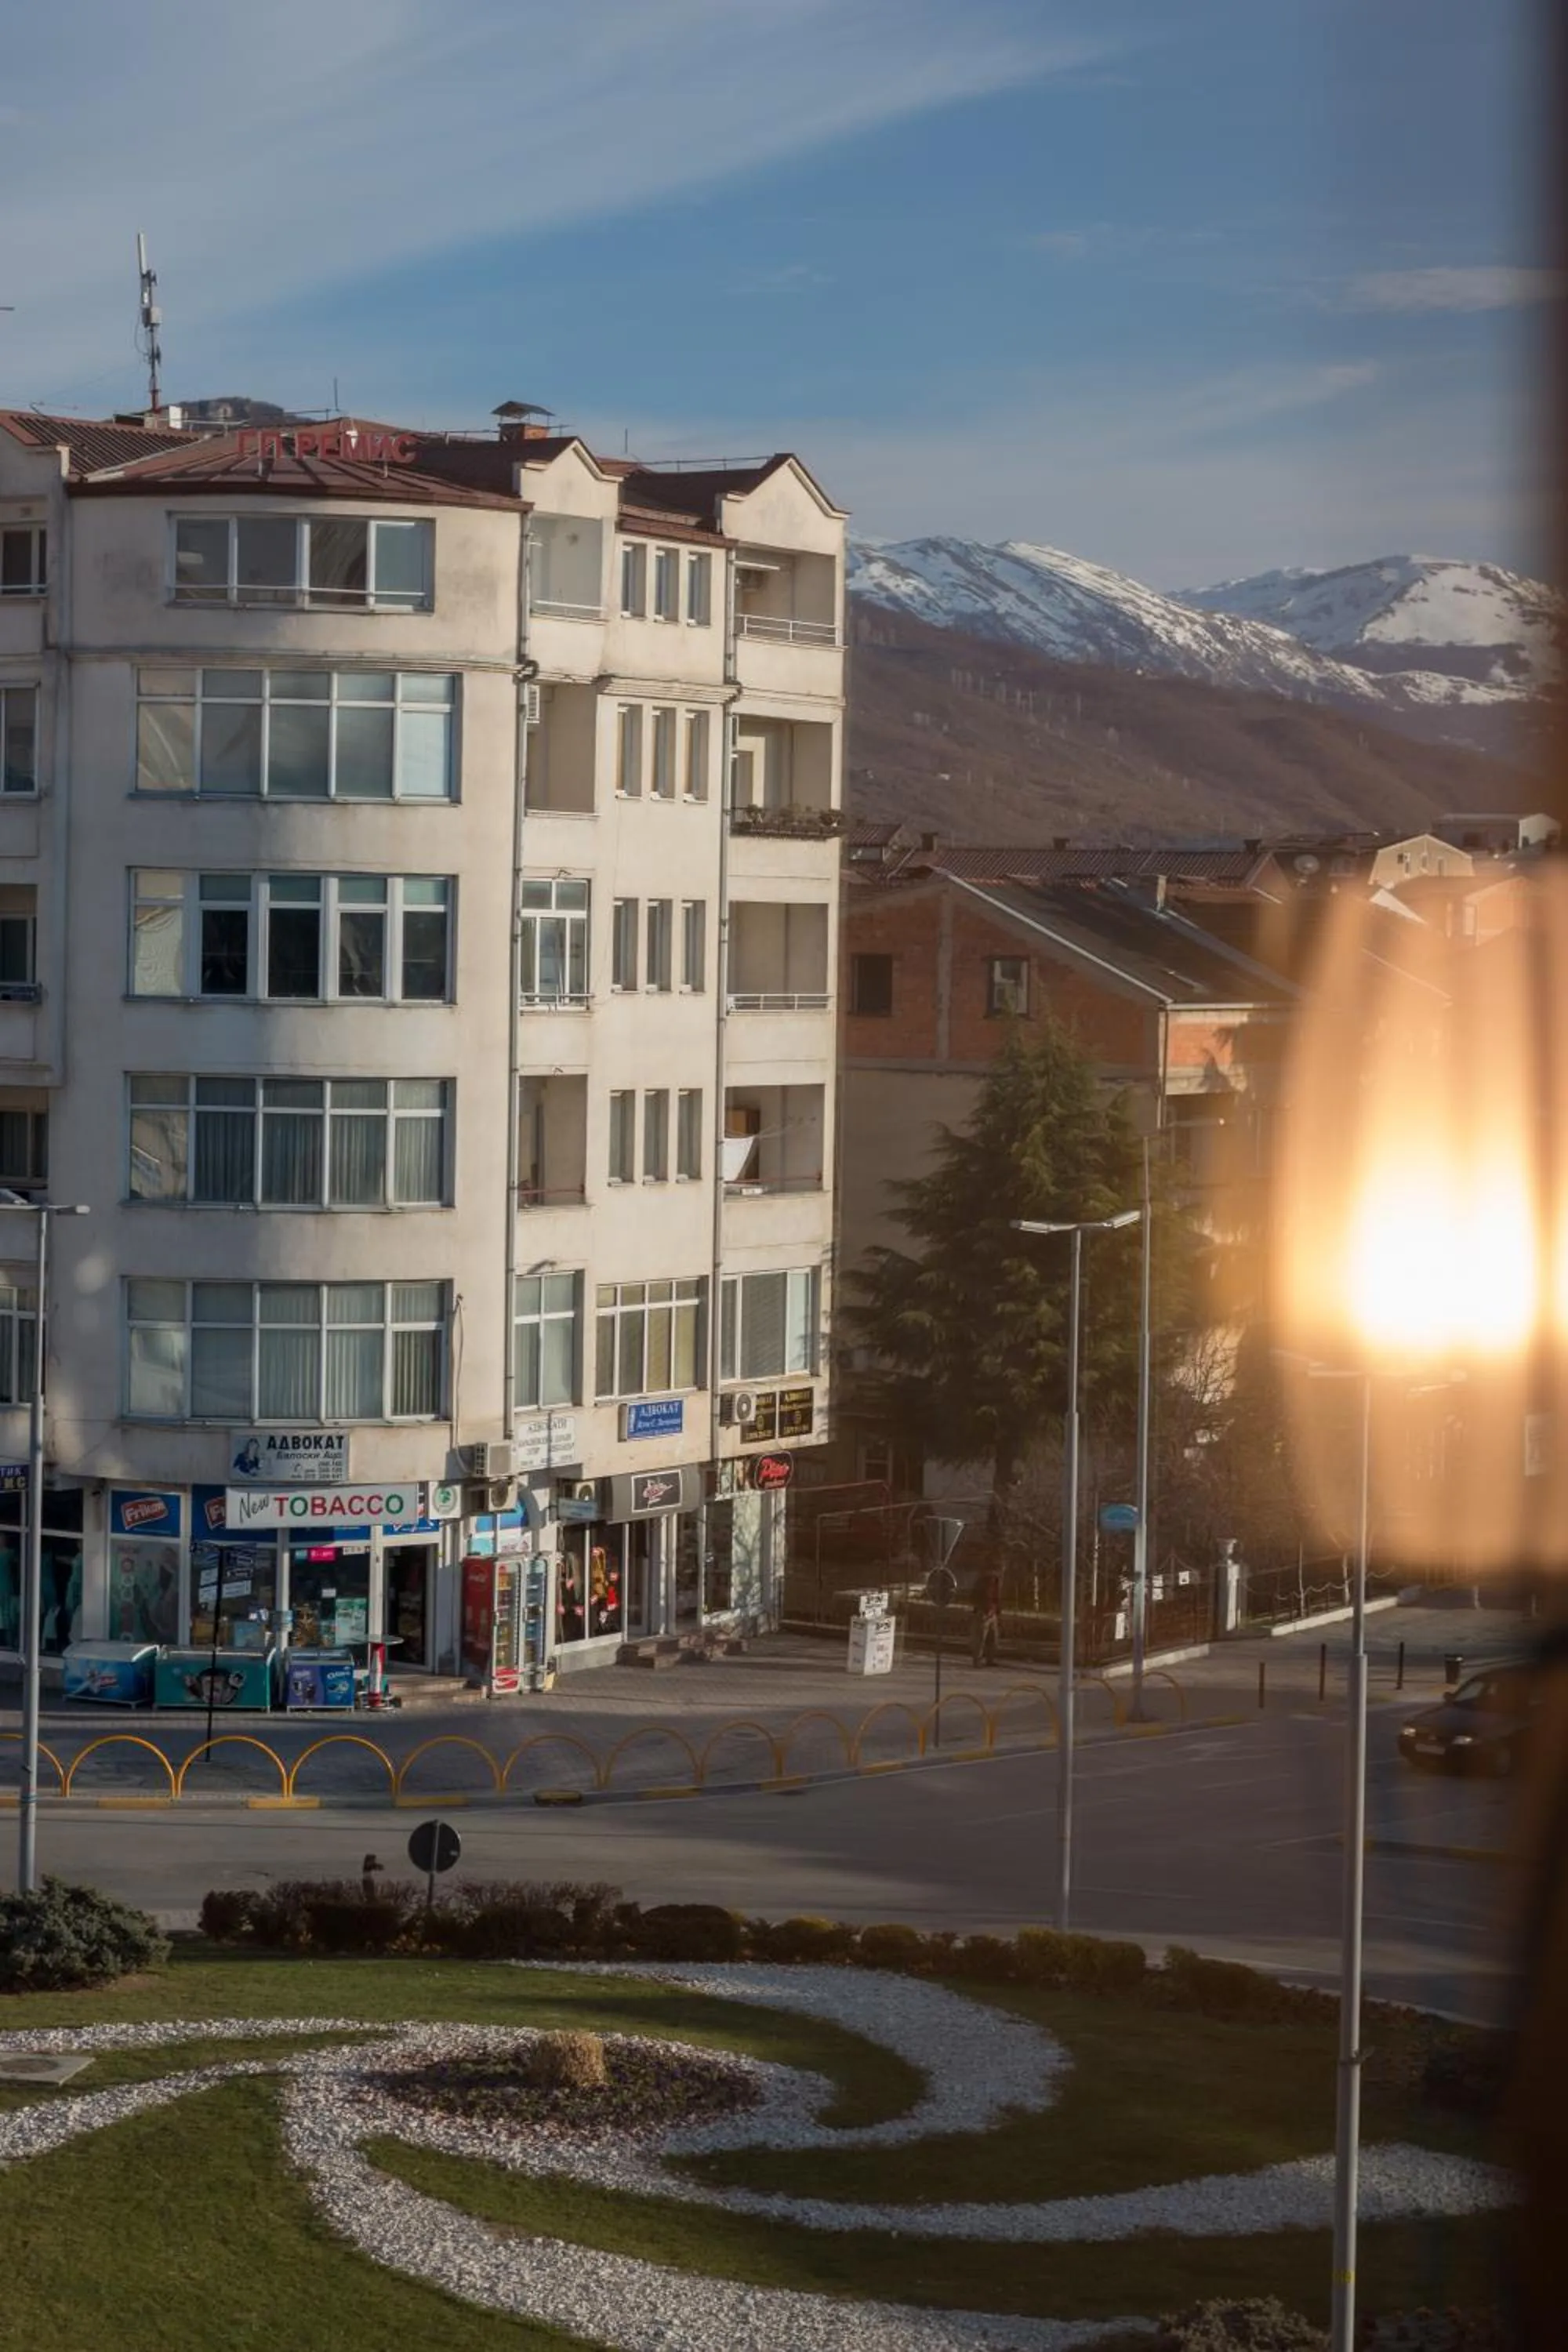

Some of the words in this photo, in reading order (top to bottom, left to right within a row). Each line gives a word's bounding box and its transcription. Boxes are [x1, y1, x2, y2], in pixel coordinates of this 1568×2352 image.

[237, 430, 283, 459] ГП
[294, 431, 419, 464] РЕМИС
[267, 1436, 344, 1450] АДВОКАТ
[239, 1492, 270, 1523] New
[274, 1494, 404, 1518] TOBACCO
